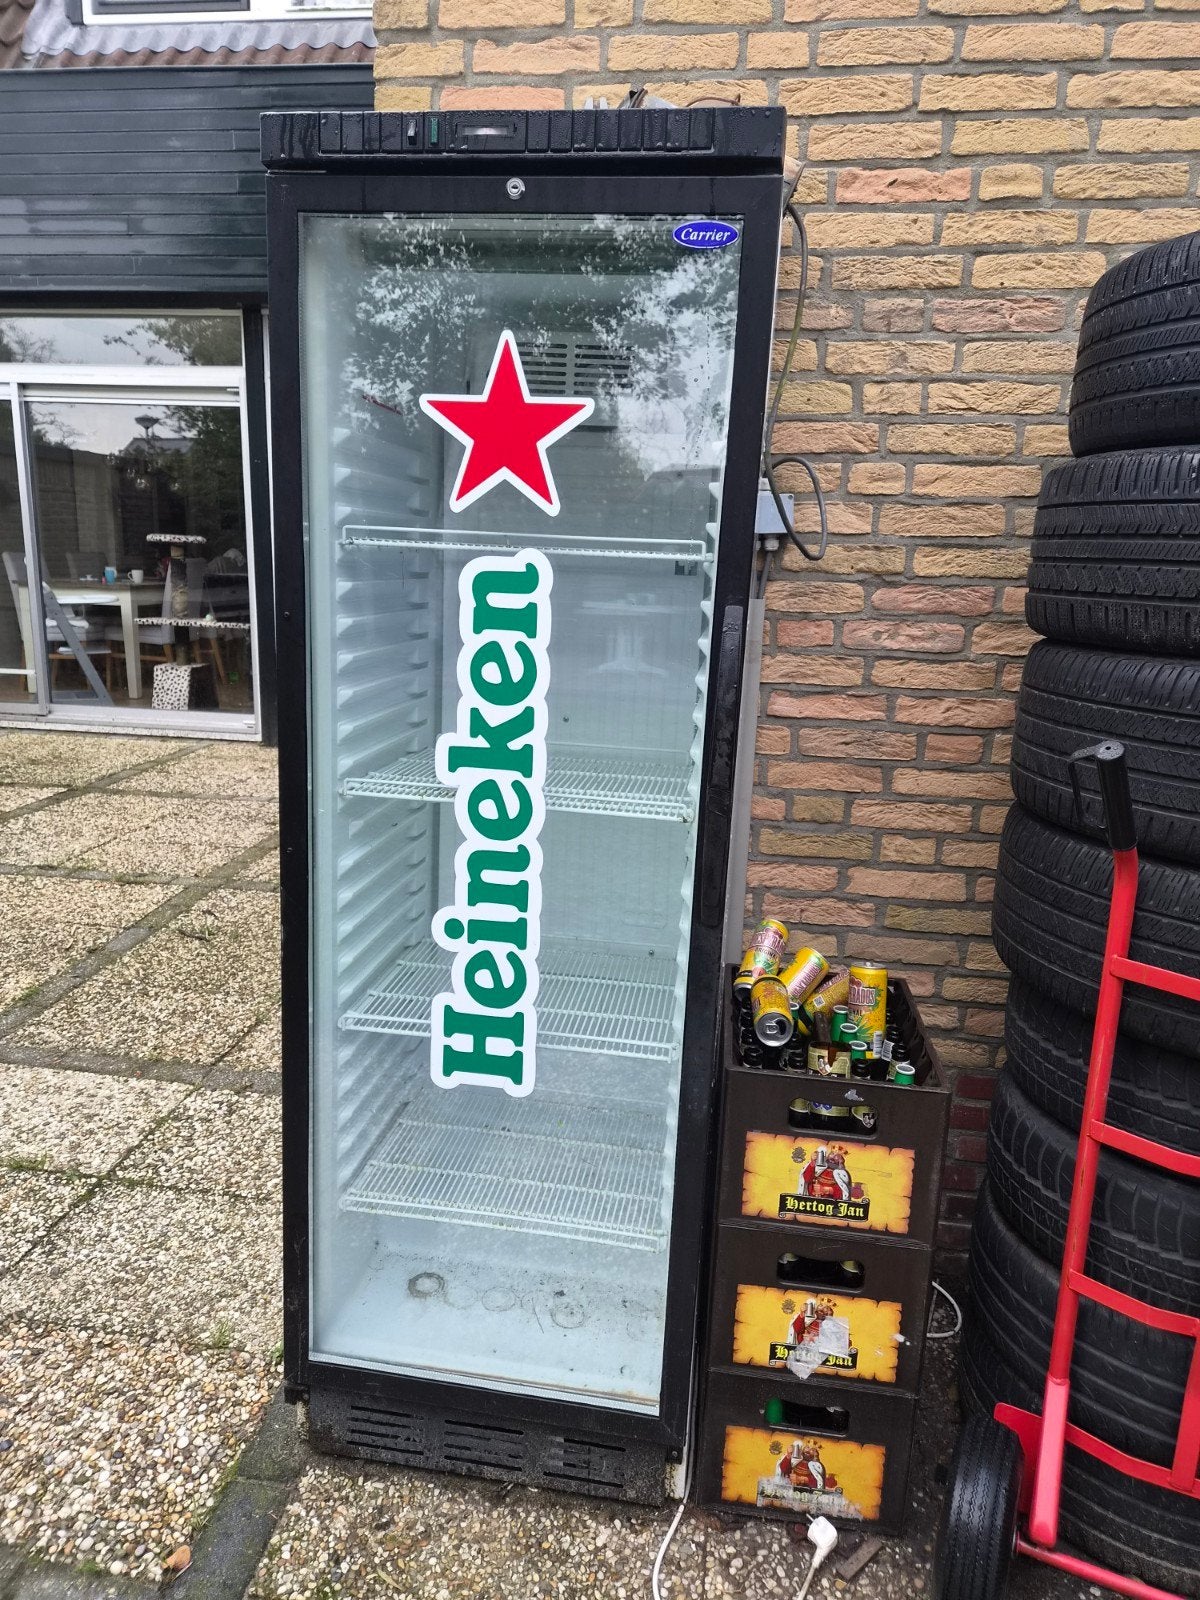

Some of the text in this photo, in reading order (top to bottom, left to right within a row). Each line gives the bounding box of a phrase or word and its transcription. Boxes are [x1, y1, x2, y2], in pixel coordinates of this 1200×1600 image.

[680, 227, 731, 241] Carrier
[442, 562, 540, 1086] Heineken
[785, 1196, 865, 1217] Hertog Jan
